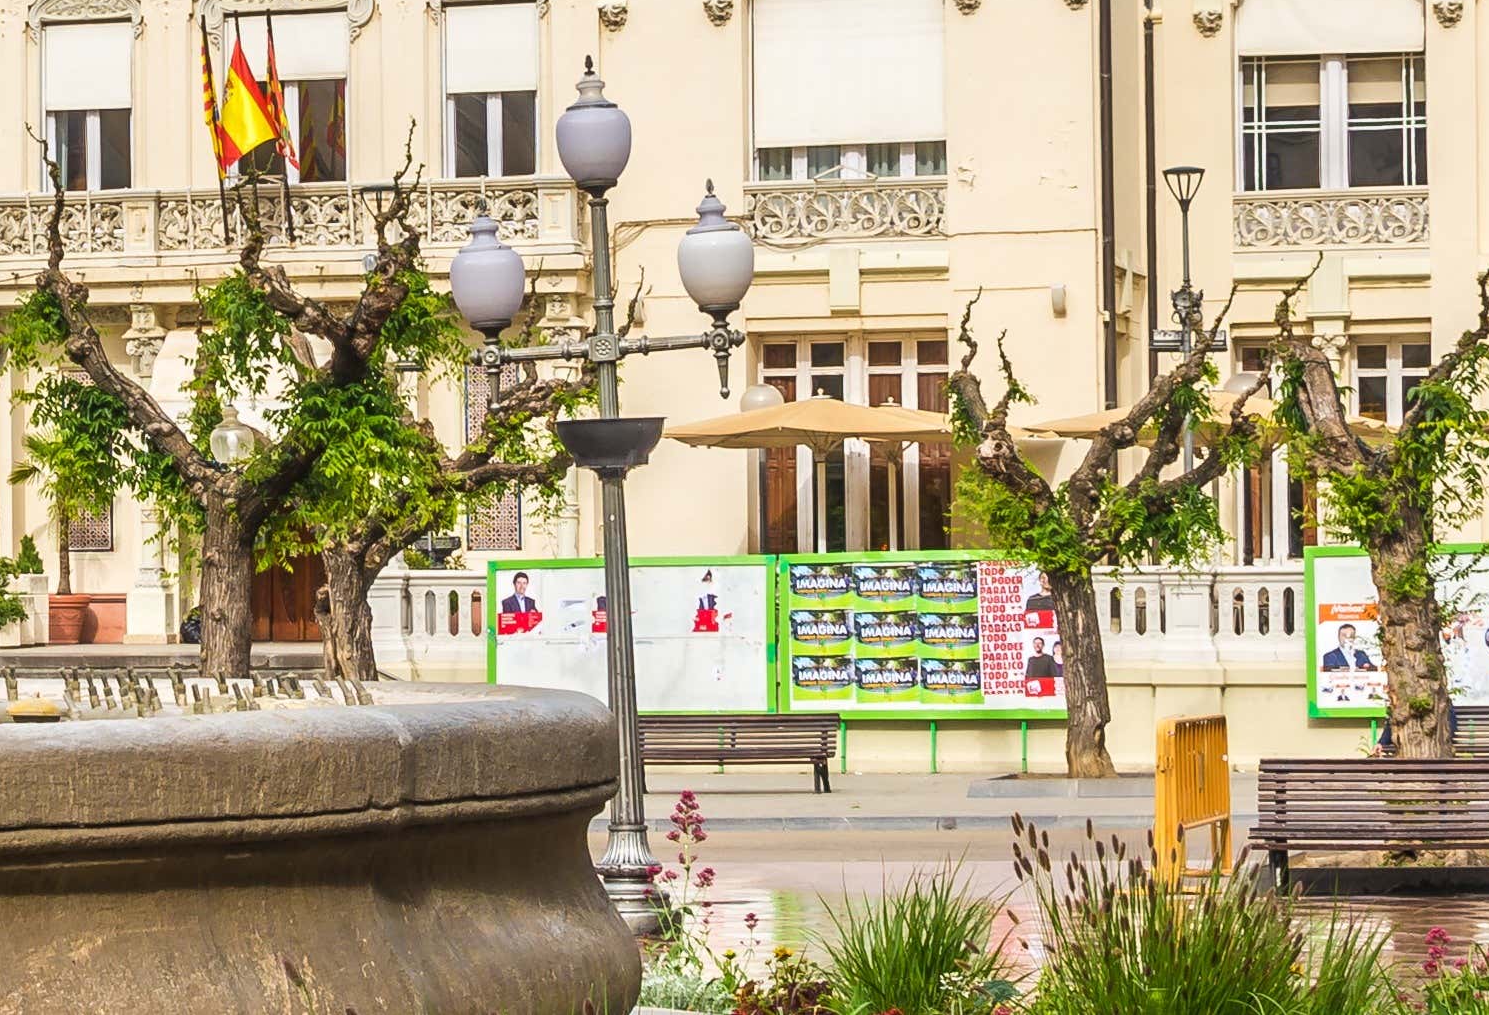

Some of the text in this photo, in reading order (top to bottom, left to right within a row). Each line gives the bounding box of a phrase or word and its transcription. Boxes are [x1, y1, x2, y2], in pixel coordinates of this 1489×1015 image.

[796, 577, 847, 589] IMAGINA
[860, 580, 911, 592] IMAGINA
[923, 582, 974, 594] IMAGINA
[981, 605, 1006, 613] TODO
[797, 623, 848, 635] IMAGINA
[861, 626, 912, 637] IMAGINA
[924, 628, 976, 639] IMAGINA
[798, 669, 849, 681] IMAGINA
[862, 672, 912, 683] IMAGINA
[927, 672, 978, 684] IMAGINA
